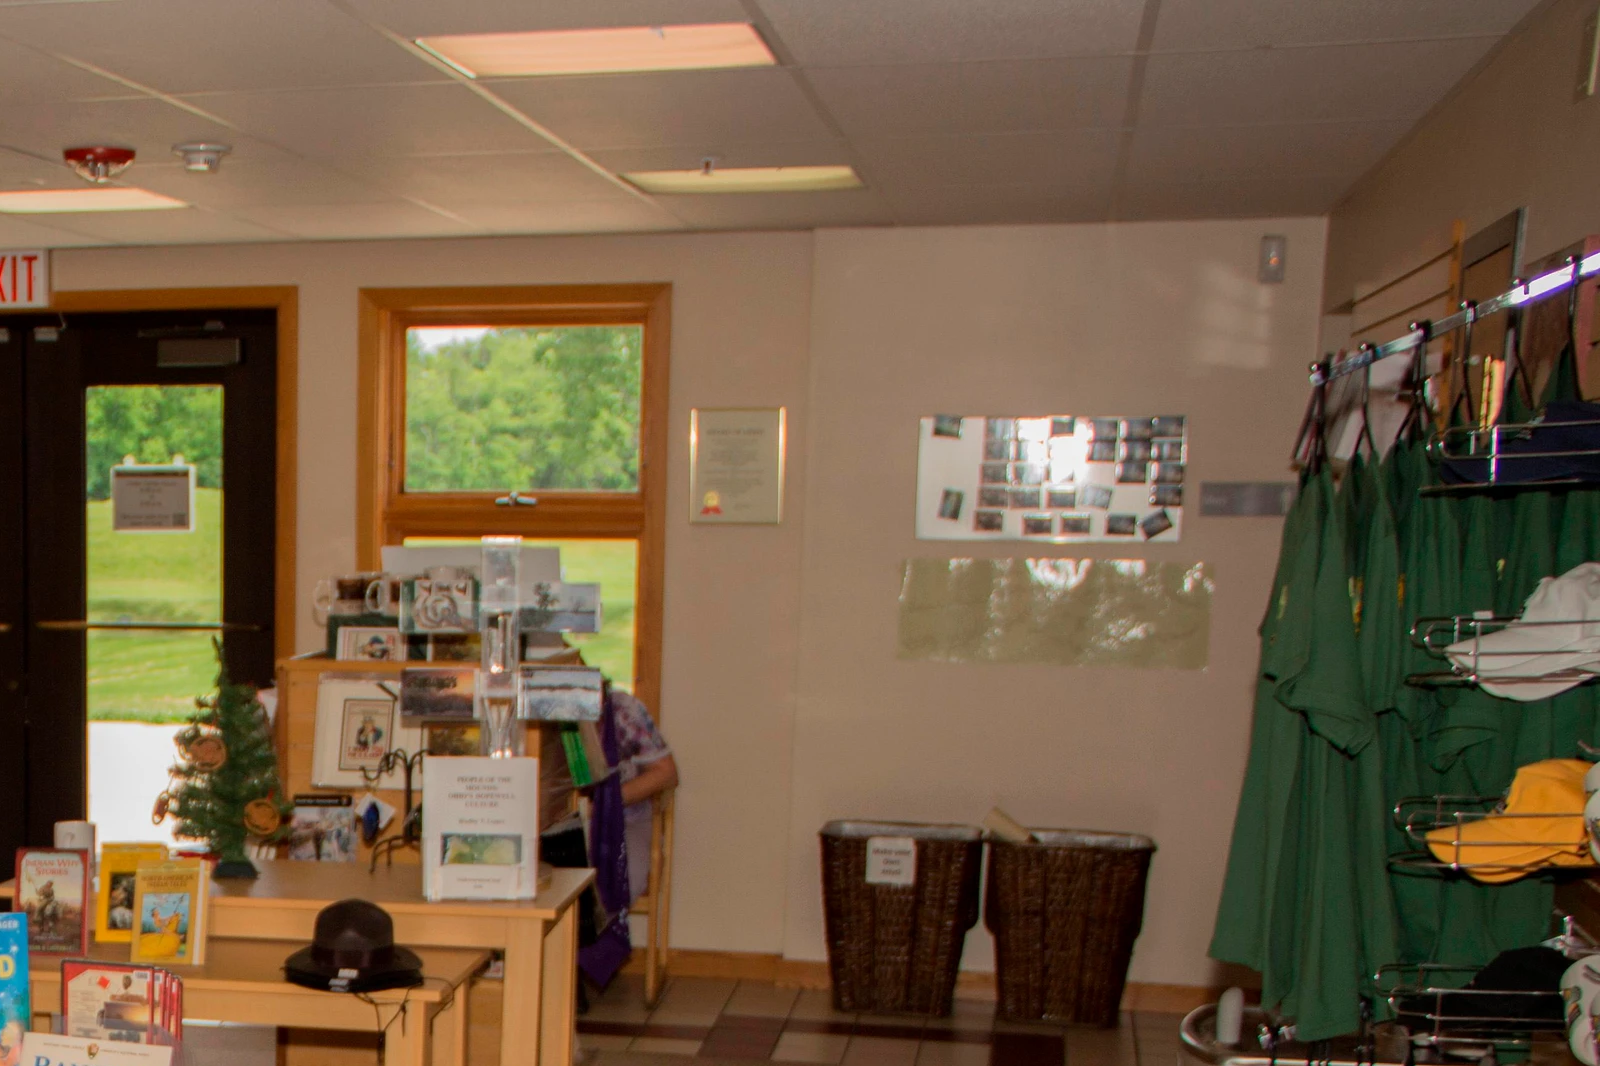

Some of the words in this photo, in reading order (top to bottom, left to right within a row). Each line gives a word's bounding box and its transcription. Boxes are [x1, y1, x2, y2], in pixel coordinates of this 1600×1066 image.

[25, 859, 54, 867] INDIAN
[57, 858, 80, 867] WHY
[35, 867, 69, 876] STORIES
